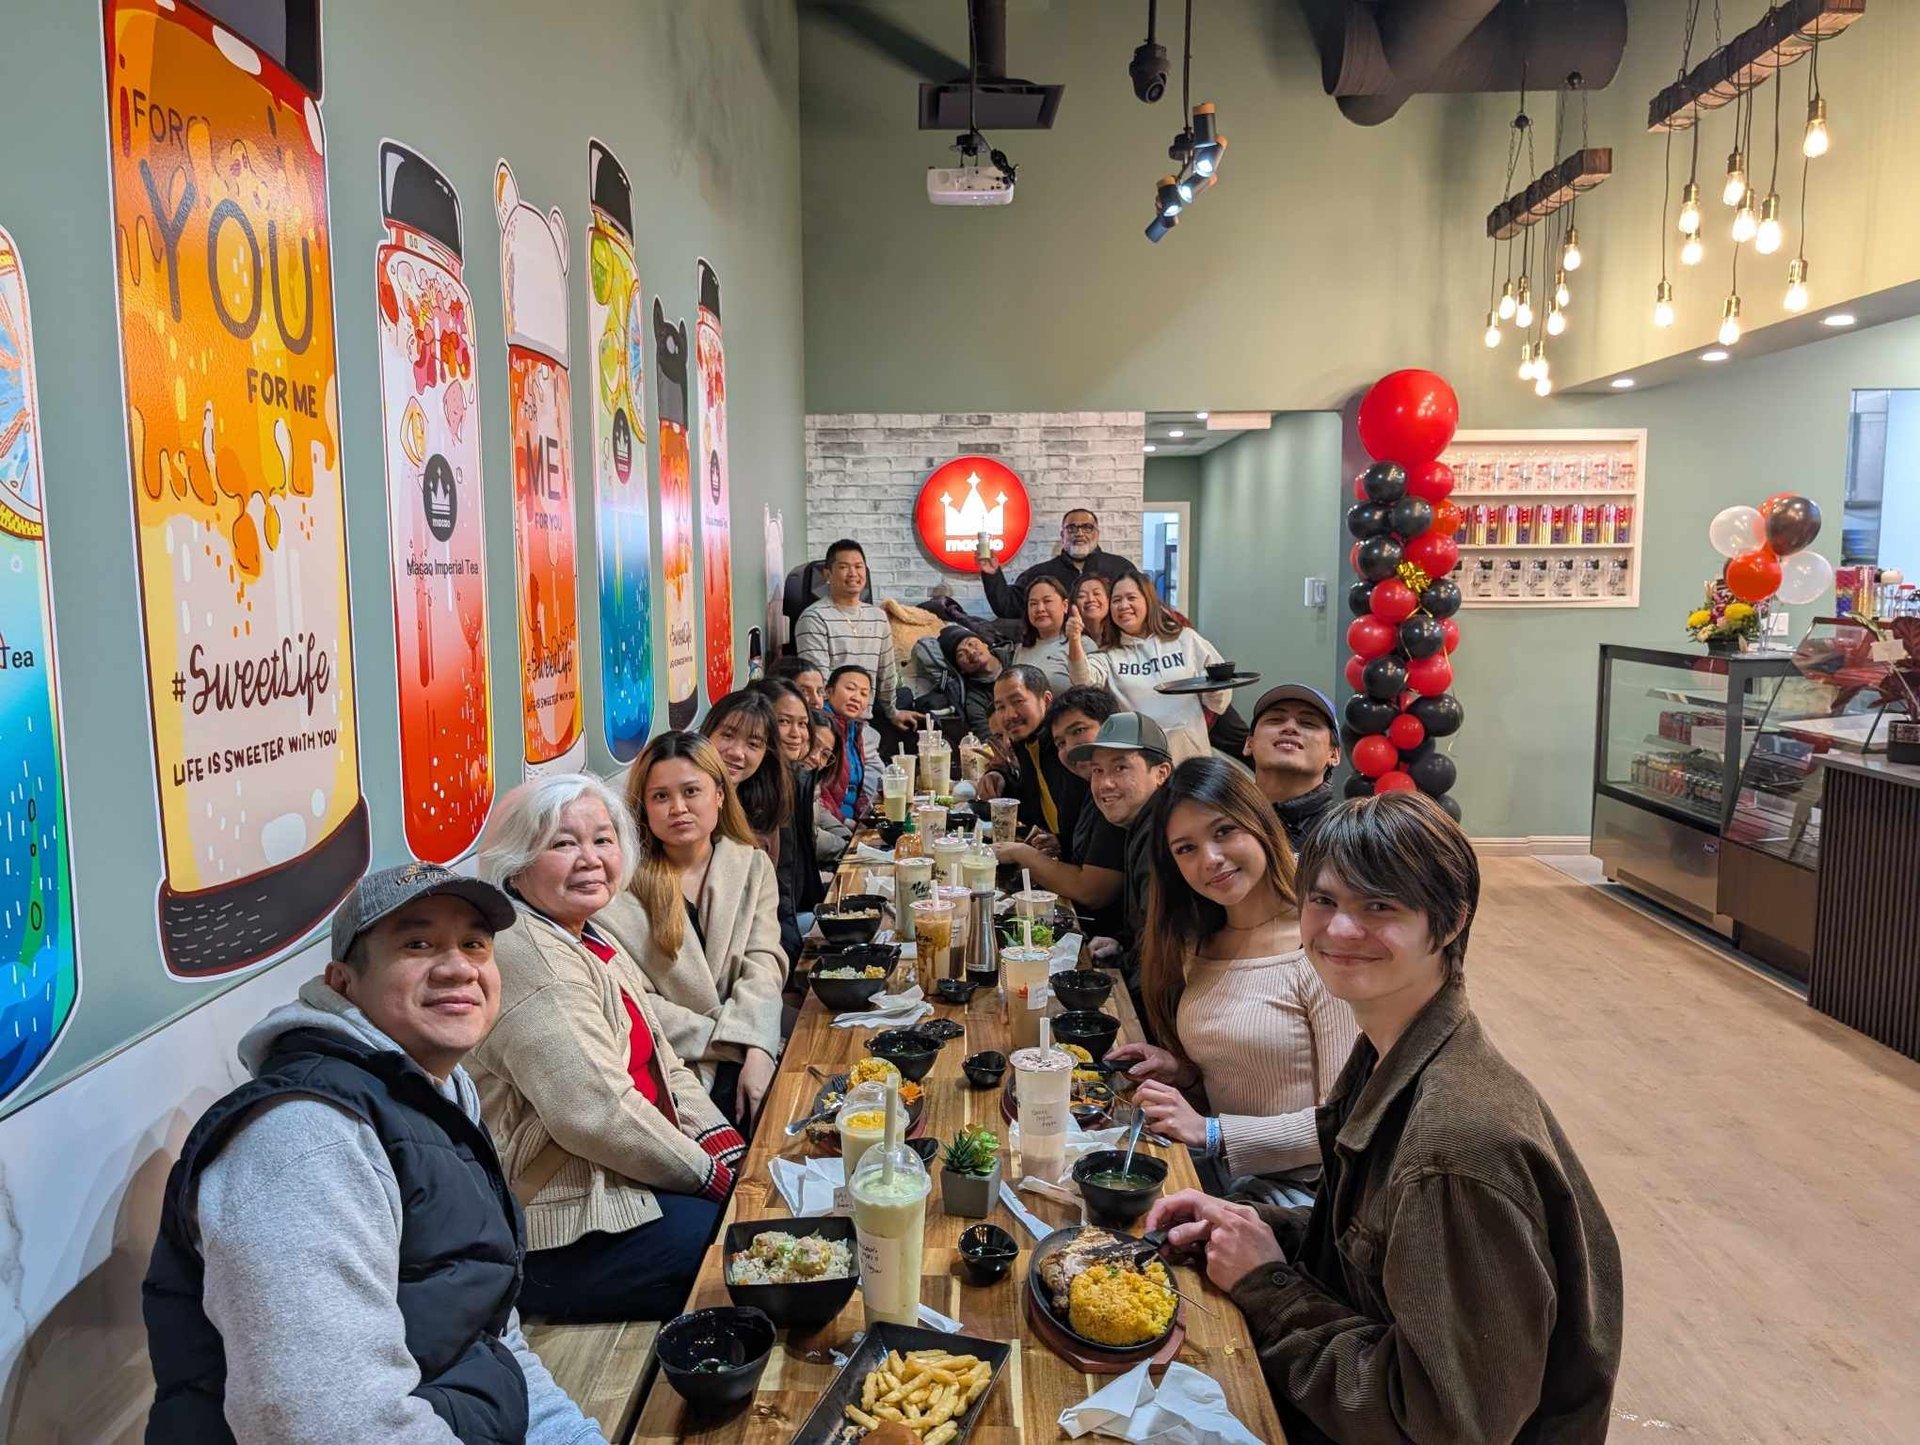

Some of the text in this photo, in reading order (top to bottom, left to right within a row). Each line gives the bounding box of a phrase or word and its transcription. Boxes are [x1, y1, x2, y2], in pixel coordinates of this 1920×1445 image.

[133, 89, 183, 144] FOR
[139, 159, 313, 355] YOU
[248, 368, 318, 418] FOR ME
[526, 430, 561, 501] ME
[435, 559, 464, 578] Imperial
[466, 559, 479, 575] Tea
[945, 539, 1004, 552] maco
[0, 646, 34, 669] Tea
[1118, 652, 1185, 676] BOSTON
[174, 728, 337, 787] LIFE IS SWEETER WITH YOU
